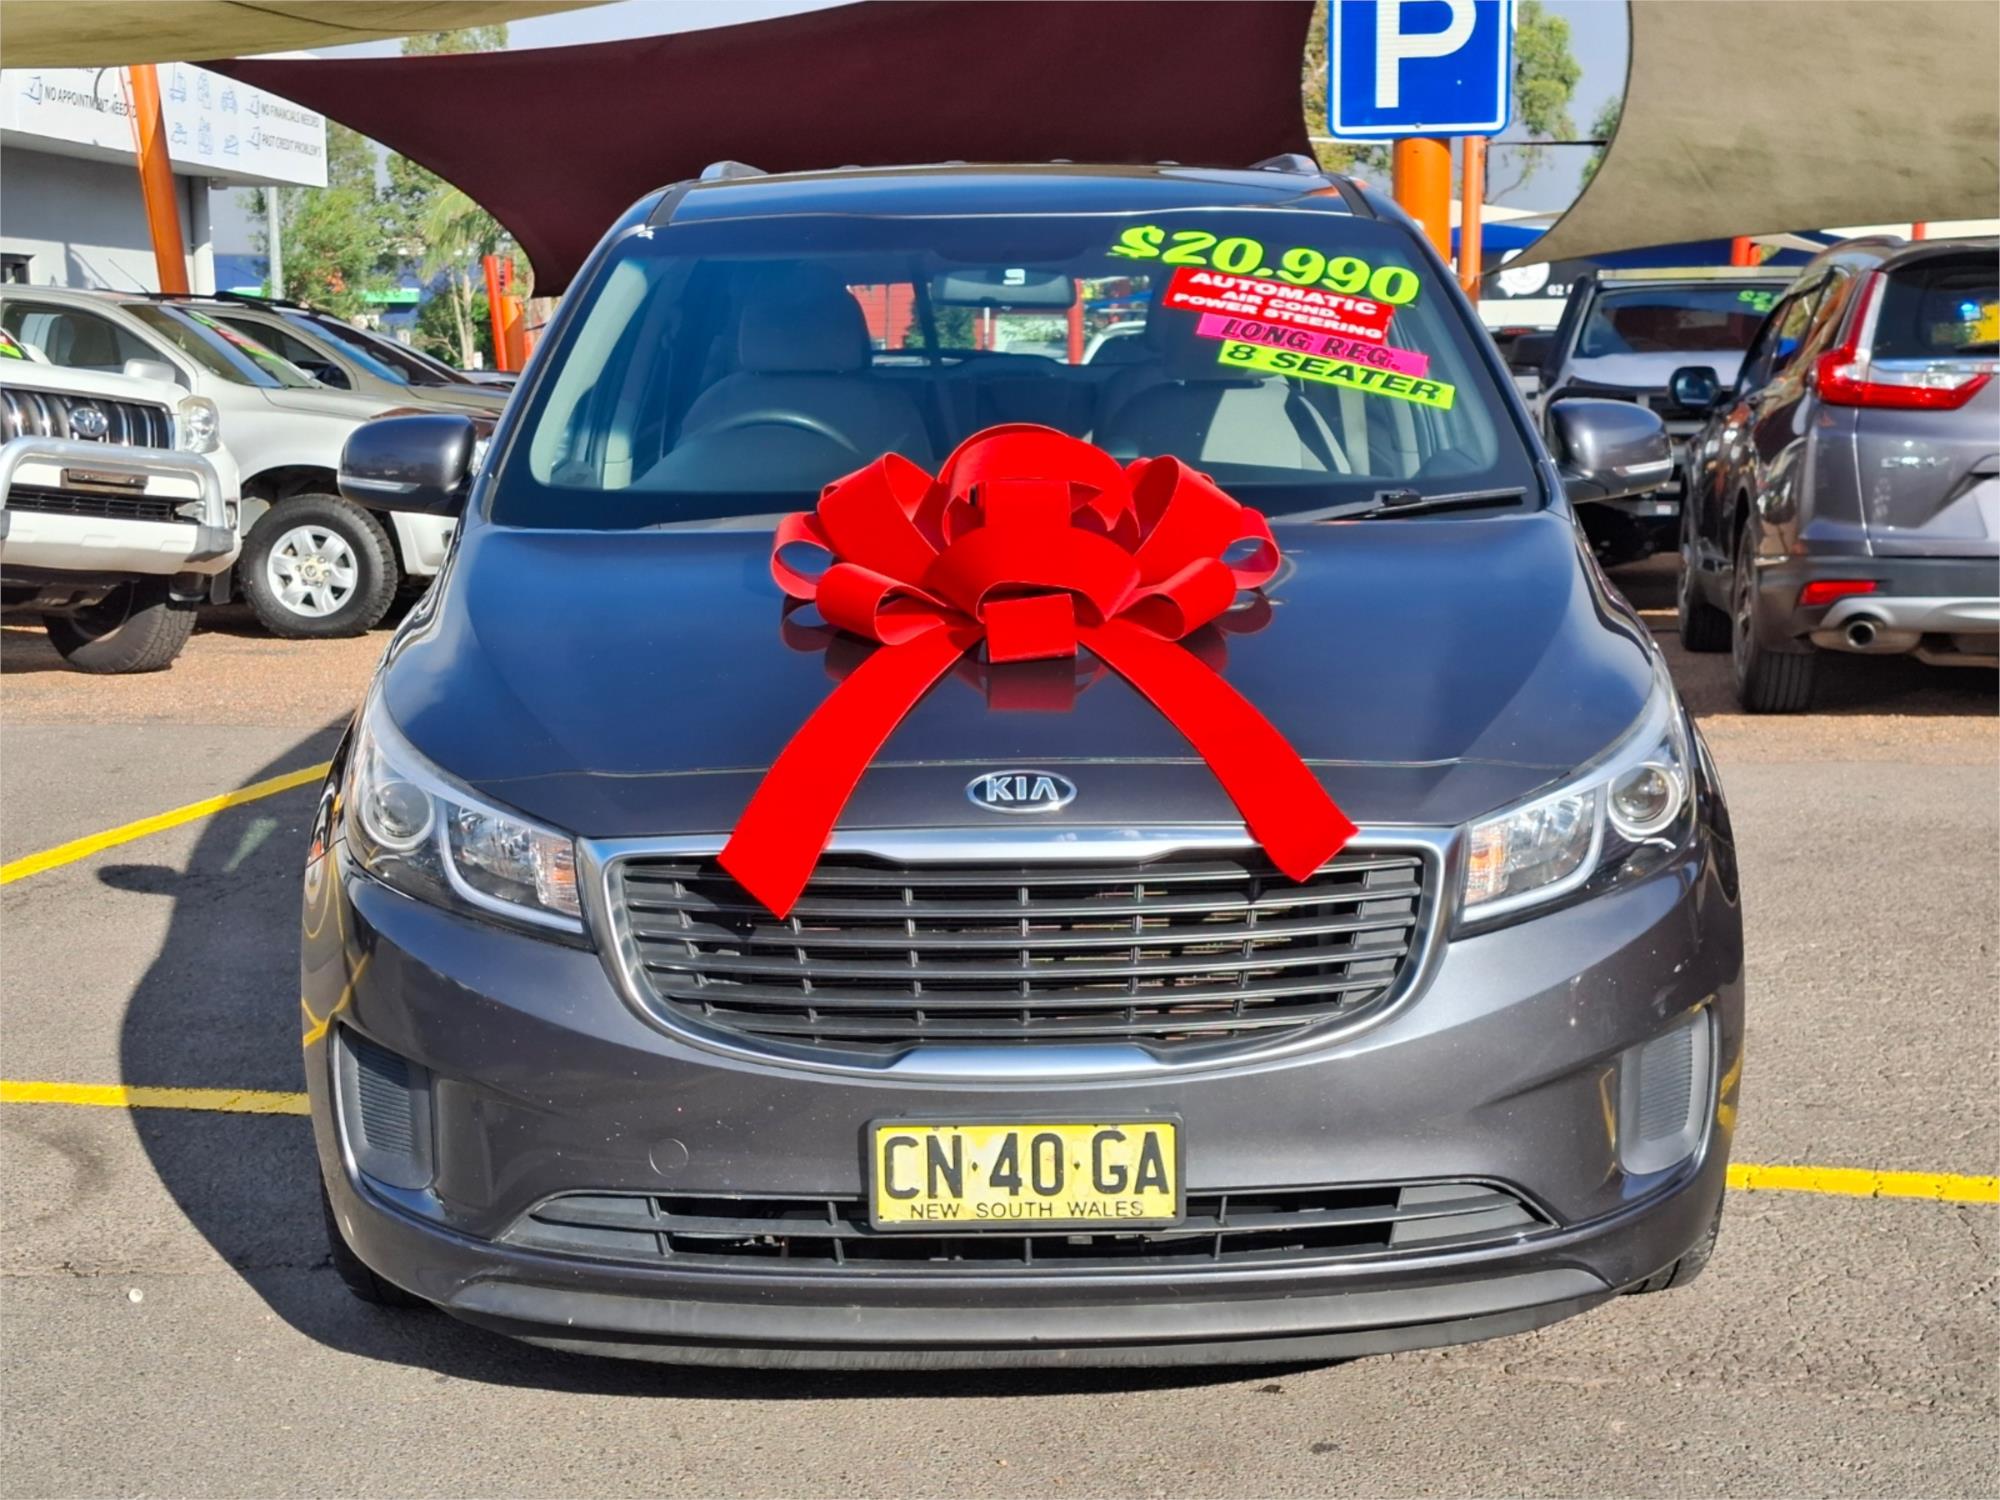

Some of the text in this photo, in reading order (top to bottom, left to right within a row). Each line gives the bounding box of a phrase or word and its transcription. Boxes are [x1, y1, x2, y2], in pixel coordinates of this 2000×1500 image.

[1375, 0, 1478, 108] P
[45, 86, 56, 101] NO
[1189, 271, 1378, 316] AUTOMATIC
[1221, 290, 1342, 320] AIR COND.
[1173, 293, 1383, 340] POWER STEERING
[1221, 318, 1401, 371] LONG REG.
[1226, 344, 1441, 401] 8 SEATER
[986, 776, 1059, 802] KIA
[910, 1200, 1144, 1220] NEW SOUTH WALES
